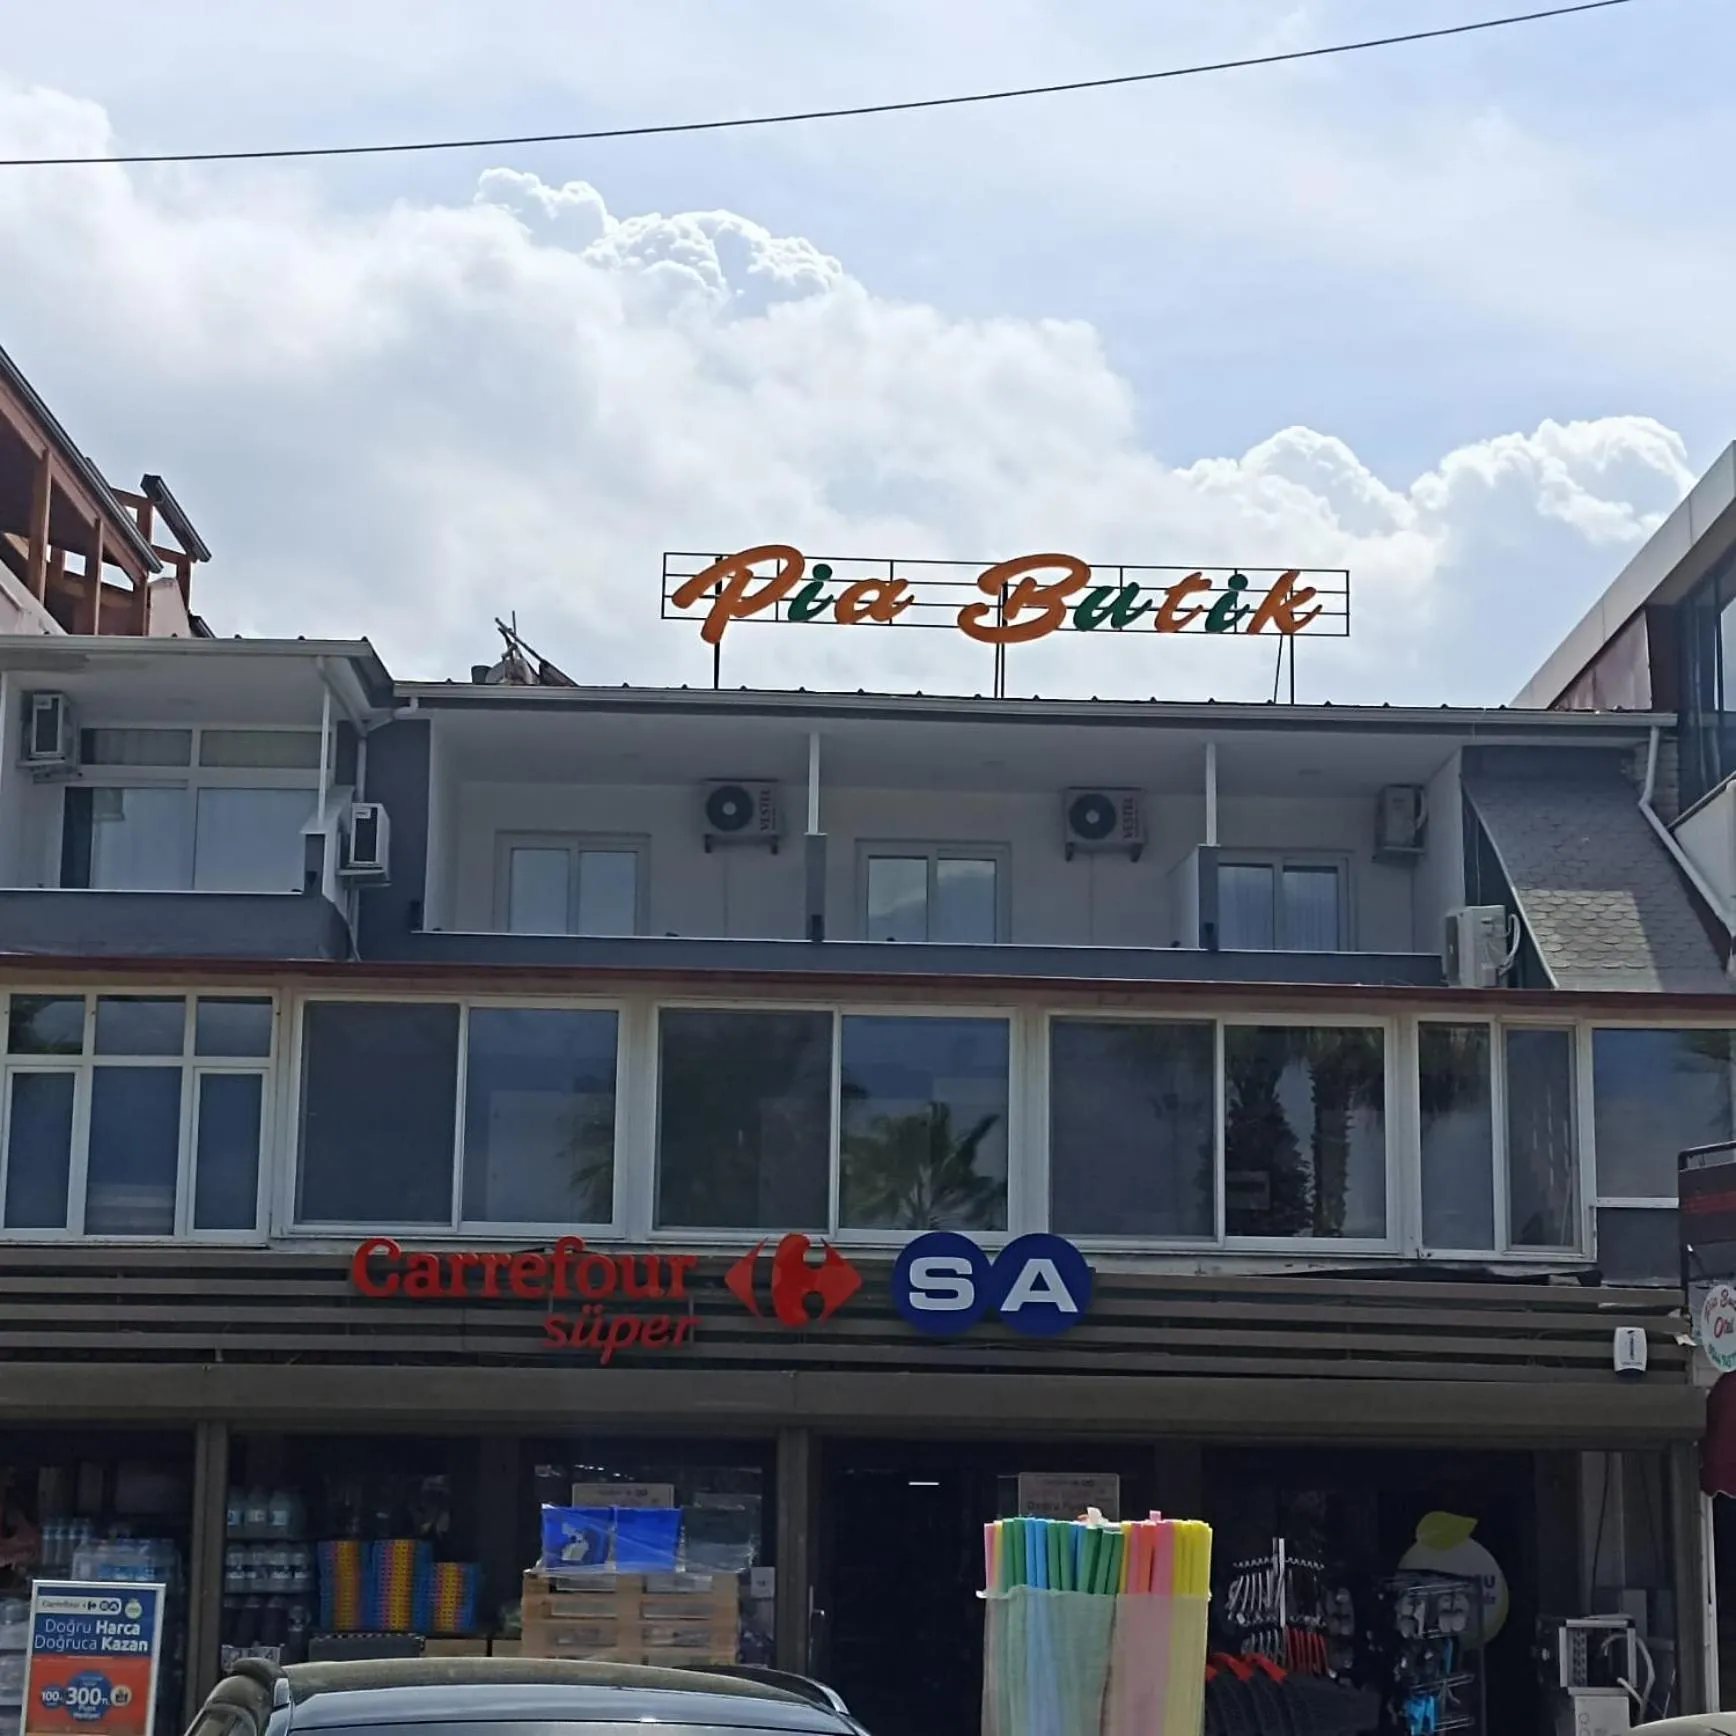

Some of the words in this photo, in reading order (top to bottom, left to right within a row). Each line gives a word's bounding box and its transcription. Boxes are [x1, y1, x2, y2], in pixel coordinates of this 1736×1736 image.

[672, 544, 914, 644] Pia
[957, 553, 1322, 644] Butik
[352, 1235, 698, 1299] Carrefour
[909, 1256, 1078, 1313] SA
[542, 1304, 702, 1365] süper
[35, 1634, 97, 1652] Doğruca
[101, 1636, 148, 1652] Kazan
[45, 1618, 91, 1636] Doğru
[96, 1620, 140, 1636] Harca
